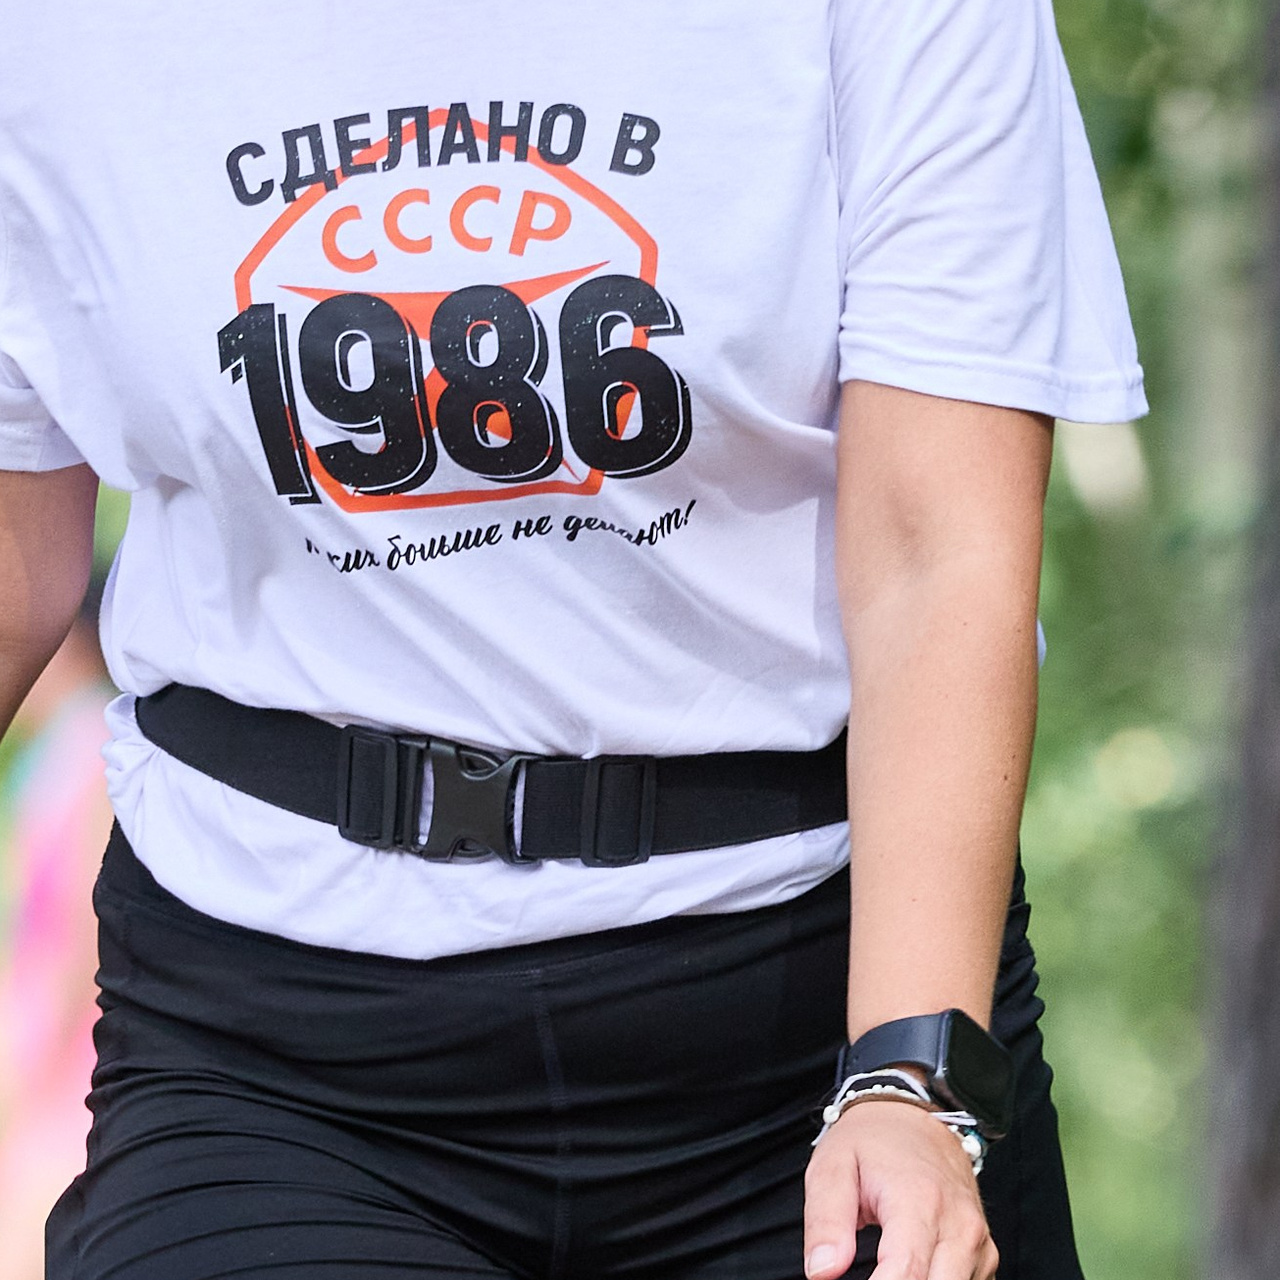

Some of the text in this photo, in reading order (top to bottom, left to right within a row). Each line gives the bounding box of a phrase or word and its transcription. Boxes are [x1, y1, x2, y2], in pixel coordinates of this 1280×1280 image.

[225, 100, 661, 207] СДЕЛАНО В
[321, 184, 572, 274] СССР
[216, 273, 693, 506] 1986
[305, 537, 381, 574] ких
[386, 528, 503, 572] больше
[511, 514, 554, 541] не
